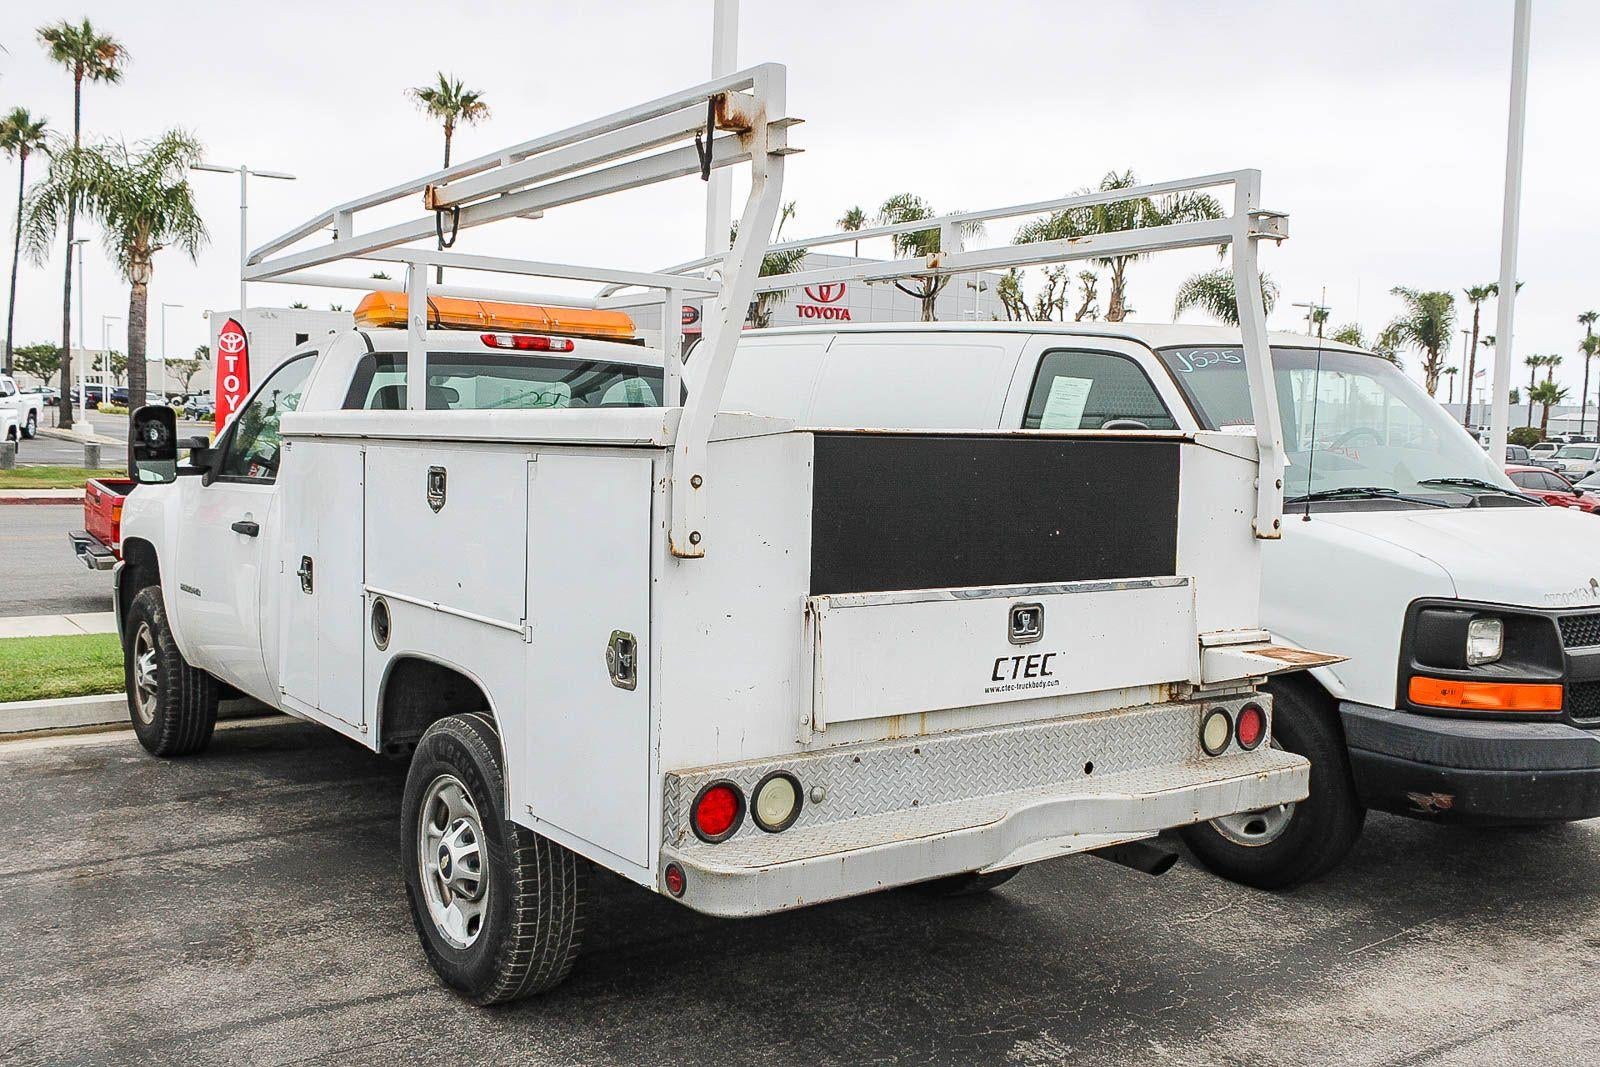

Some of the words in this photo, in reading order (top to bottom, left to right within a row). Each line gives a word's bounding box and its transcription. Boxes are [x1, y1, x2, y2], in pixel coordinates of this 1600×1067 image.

[796, 304, 851, 321] TOYOTA
[991, 653, 1057, 682] CTEC
[984, 679, 1060, 694] www.ctec-truckbody.com
